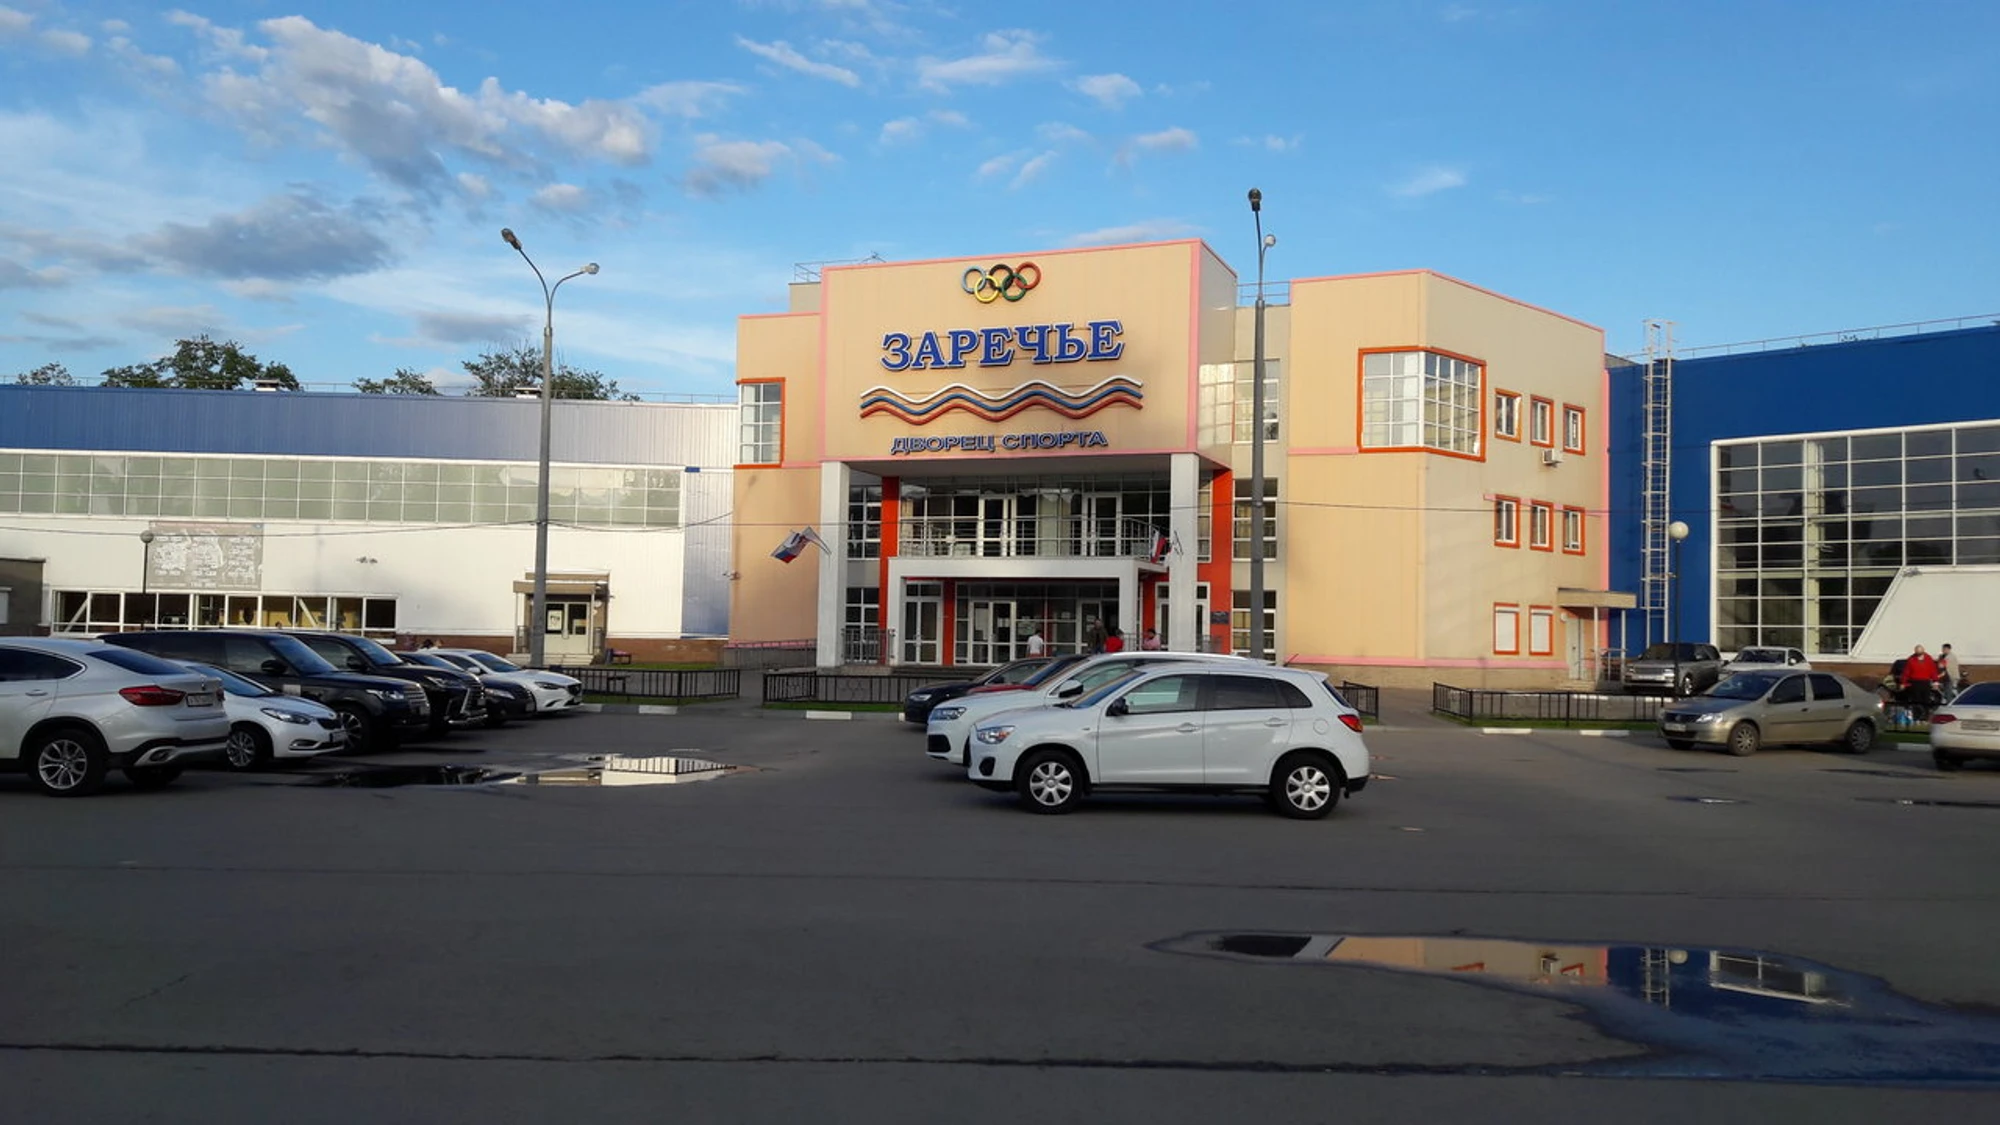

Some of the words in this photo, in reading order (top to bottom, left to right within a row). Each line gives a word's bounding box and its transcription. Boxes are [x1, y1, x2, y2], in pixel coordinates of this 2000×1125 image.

[880, 319, 1125, 371] ЗАРЕЧЬЕ
[891, 434, 995, 455] ДВОРЕЦ
[1002, 431, 1108, 449] СПОРТА
